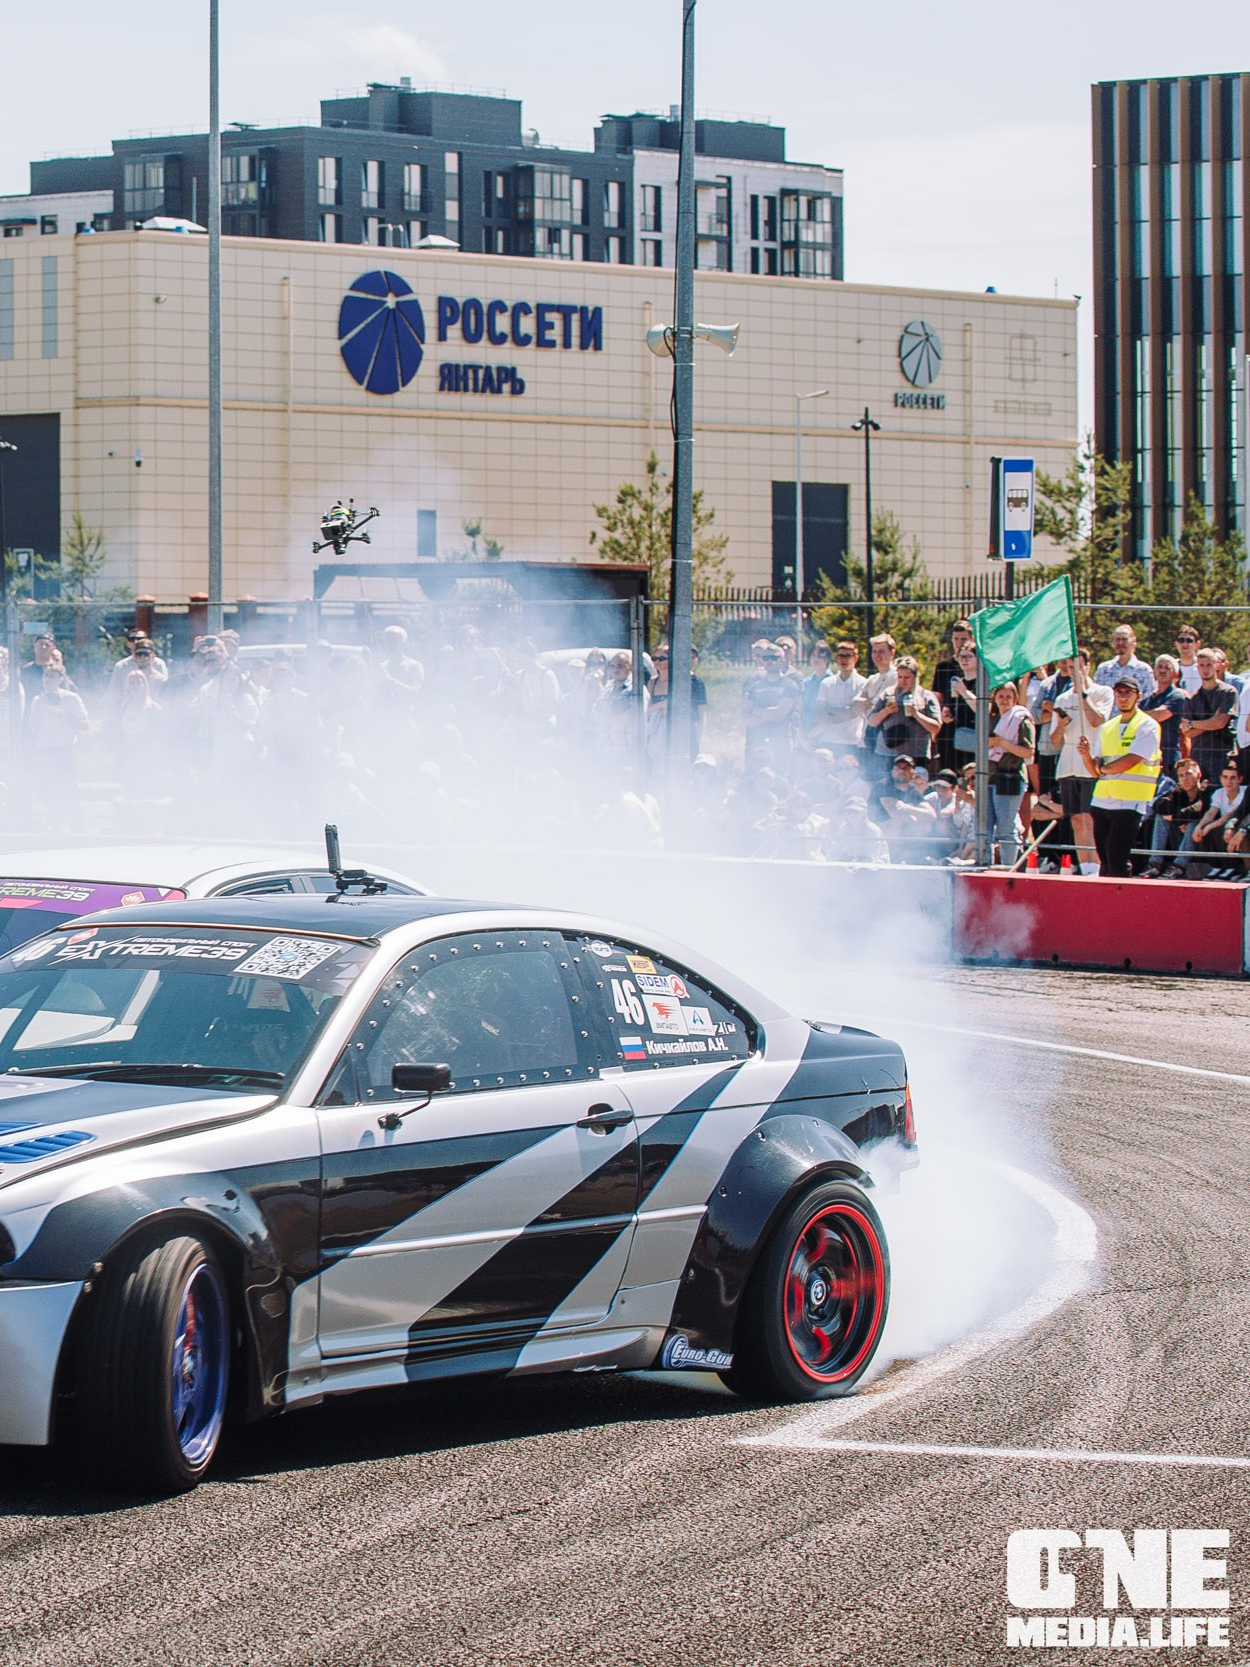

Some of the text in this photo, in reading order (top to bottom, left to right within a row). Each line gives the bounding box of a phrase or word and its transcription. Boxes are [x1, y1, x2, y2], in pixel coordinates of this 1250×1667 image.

[437, 295, 603, 351] РОССЕТИ
[438, 362, 526, 396] ЯНТАРЬ
[893, 391, 946, 410] РОССЕТИ
[637, 975, 670, 989] SIDEM
[610, 978, 645, 1026] 46
[646, 1036, 729, 1055] Кичкайлов А.Н.
